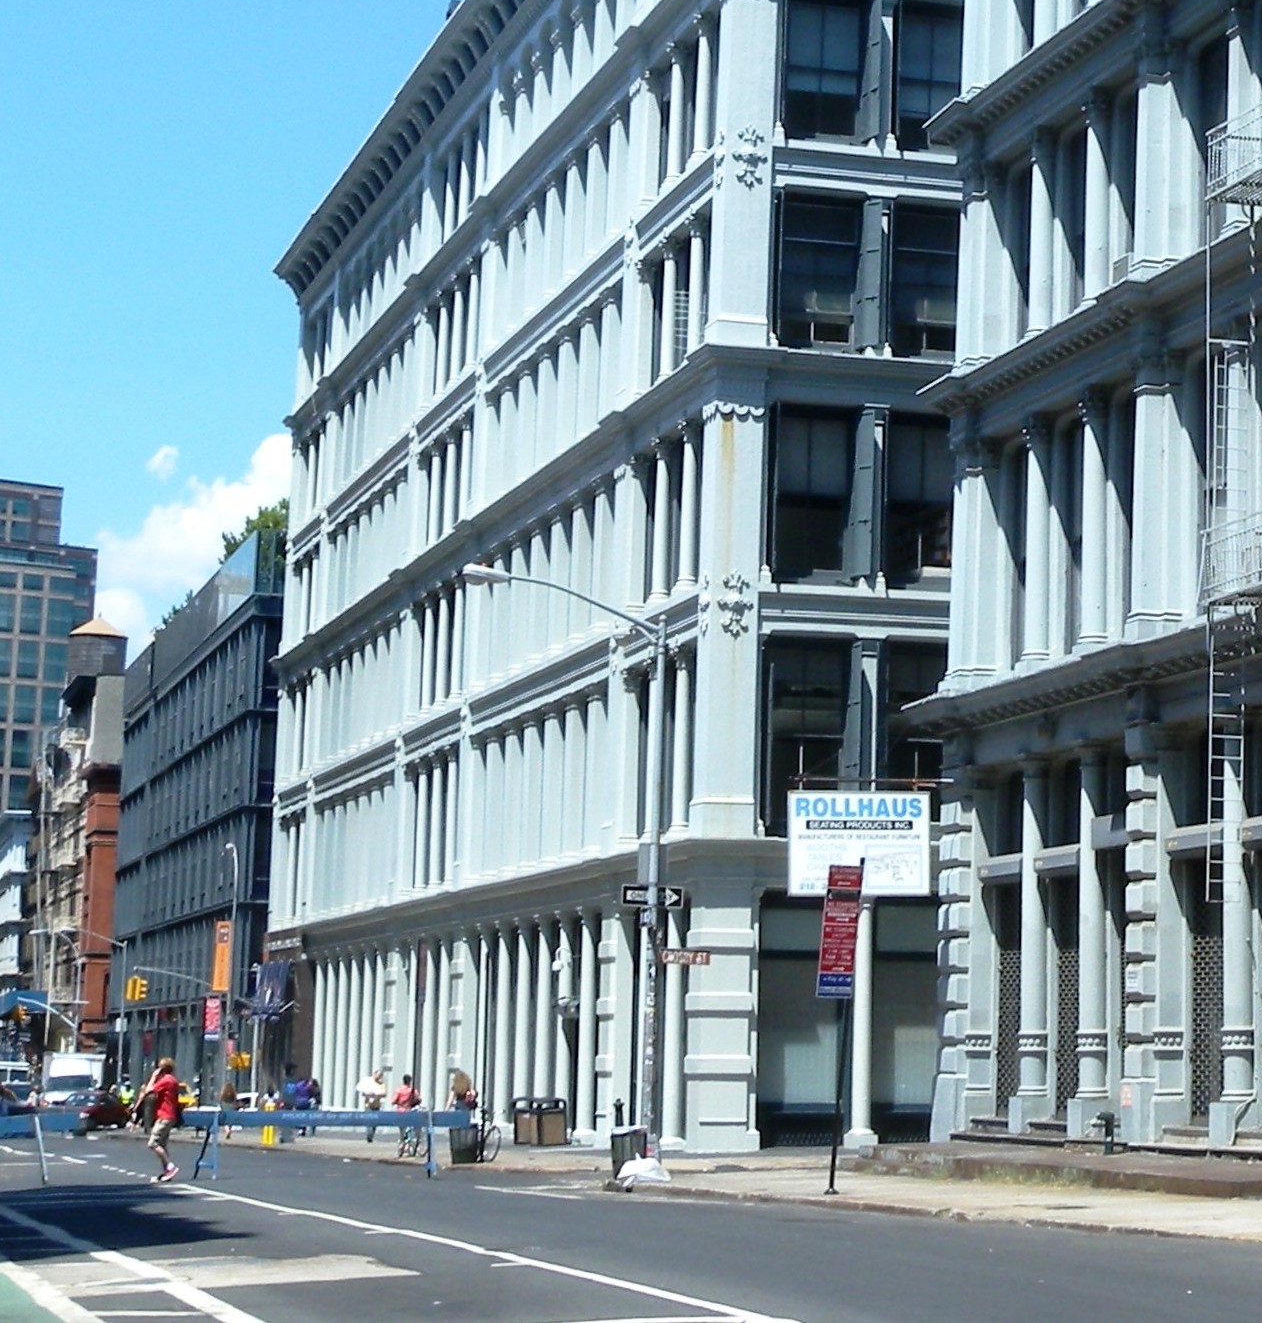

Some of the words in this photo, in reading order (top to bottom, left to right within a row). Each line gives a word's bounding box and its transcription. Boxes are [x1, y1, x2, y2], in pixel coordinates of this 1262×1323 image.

[795, 797, 922, 817] ROLLHAUS
[809, 820, 845, 830] SEATING
[846, 820, 893, 830] PRODUCTS
[662, 950, 694, 964] COSBY
